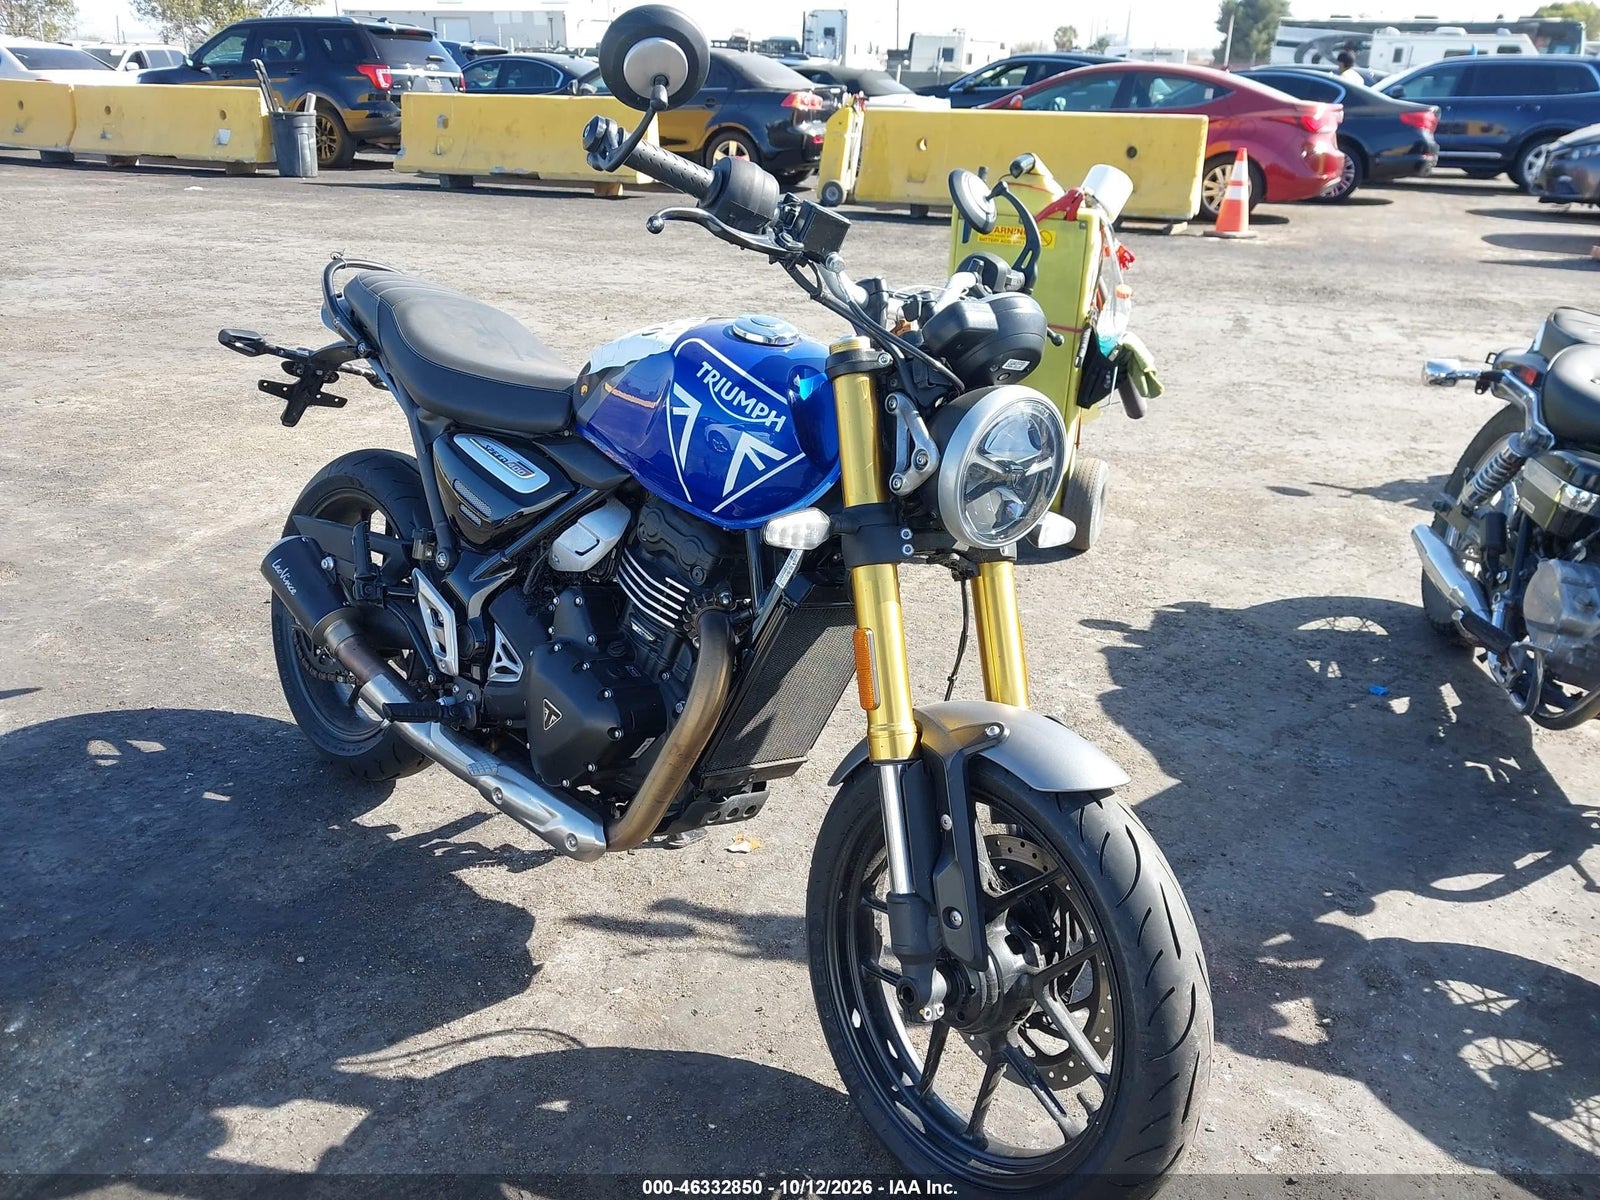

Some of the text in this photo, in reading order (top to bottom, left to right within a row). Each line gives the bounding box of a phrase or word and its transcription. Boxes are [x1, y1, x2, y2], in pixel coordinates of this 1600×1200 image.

[993, 226, 1026, 236] ARNIN
[696, 361, 786, 432] TRIUMPH
[272, 558, 297, 596] LeoVince
